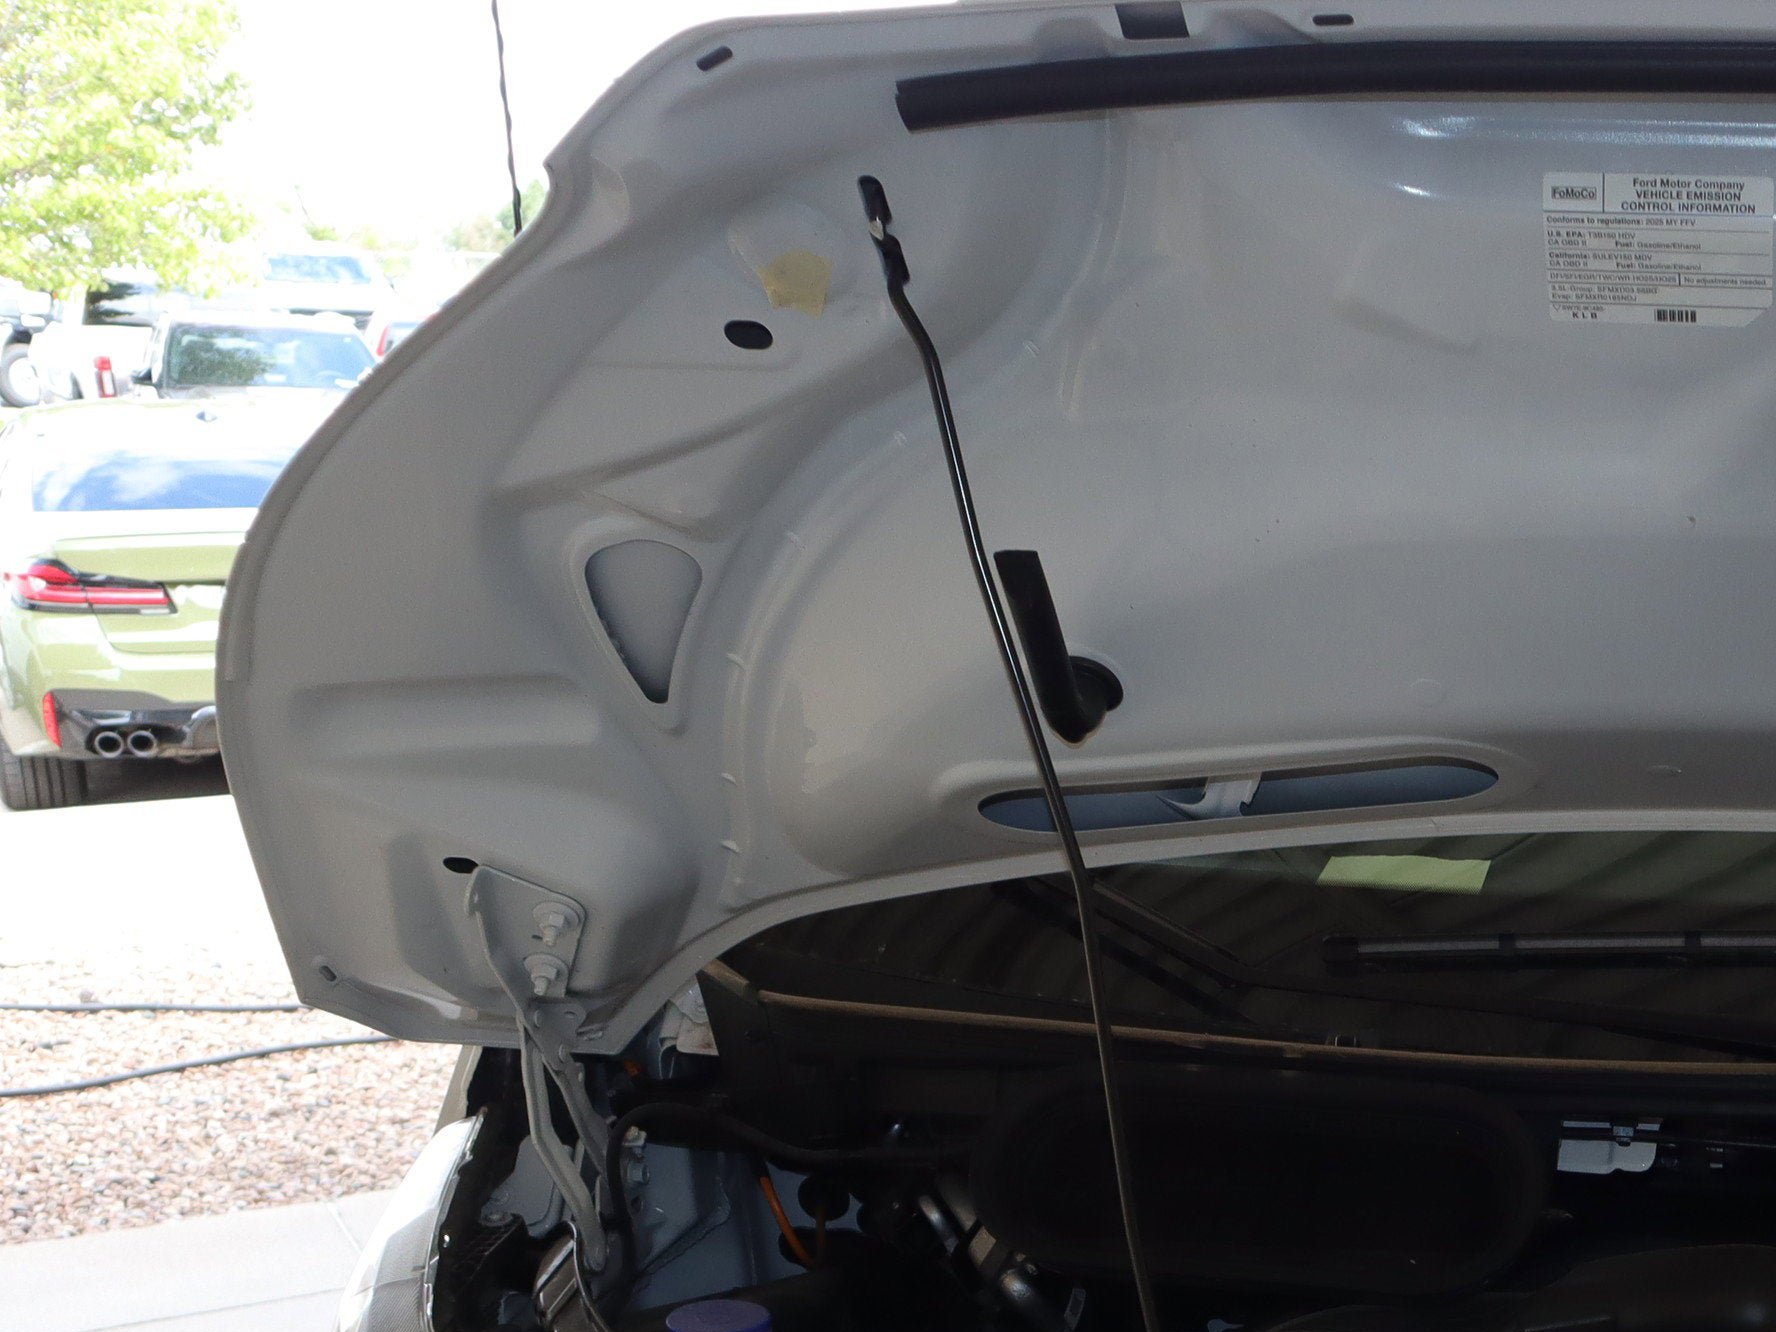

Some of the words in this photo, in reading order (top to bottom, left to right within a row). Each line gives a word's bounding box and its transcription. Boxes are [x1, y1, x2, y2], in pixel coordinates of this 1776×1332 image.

[1633, 178, 1656, 188] Ford
[1660, 179, 1690, 189] Motor
[1695, 179, 1745, 191] Company
[1553, 187, 1596, 199] FoMoCo
[1636, 190, 1682, 200] VEHICLE
[1687, 192, 1741, 201] EMISSION
[1621, 202, 1674, 212] CONTROL
[1678, 204, 1755, 214] INFORMATION
[1547, 216, 1584, 224] Conforms
[1597, 218, 1643, 227] regulations:
